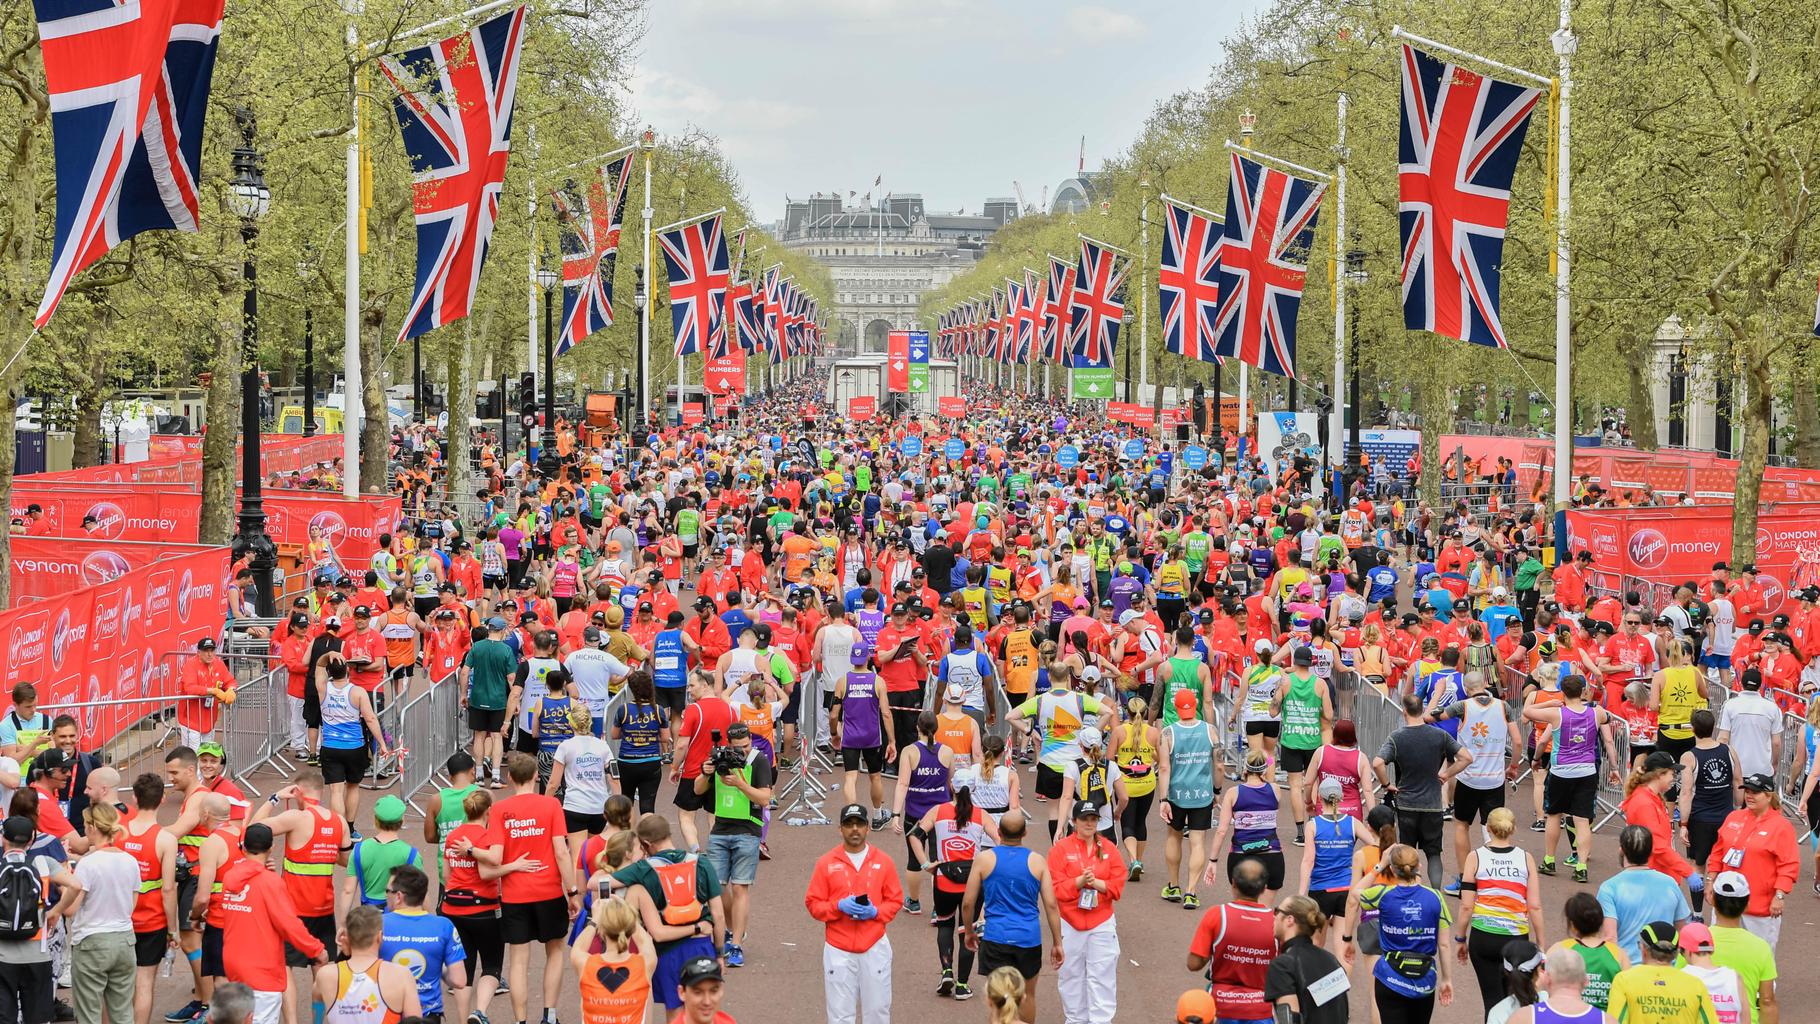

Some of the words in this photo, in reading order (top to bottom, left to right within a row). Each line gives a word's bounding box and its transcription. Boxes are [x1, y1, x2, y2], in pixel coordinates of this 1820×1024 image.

[127, 518, 177, 533] money
[1775, 531, 1817, 540] LONDON
[1632, 535, 1665, 563] Virgin
[1670, 541, 1721, 555] money
[192, 583, 214, 601] money
[22, 628, 43, 645] LONDON
[777, 642, 793, 650] JAMES
[575, 654, 605, 662] MICHAEL
[504, 819, 536, 829] #Team
[510, 827, 546, 838] Shelter
[1491, 858, 1513, 866] Team
[411, 935, 439, 943] support
[1227, 944, 1239, 954] my
[1240, 945, 1270, 956] support
[1223, 952, 1254, 964] changes
[1637, 995, 1688, 1007] AUSTRALIA
[1641, 1005, 1681, 1016] DANNY
